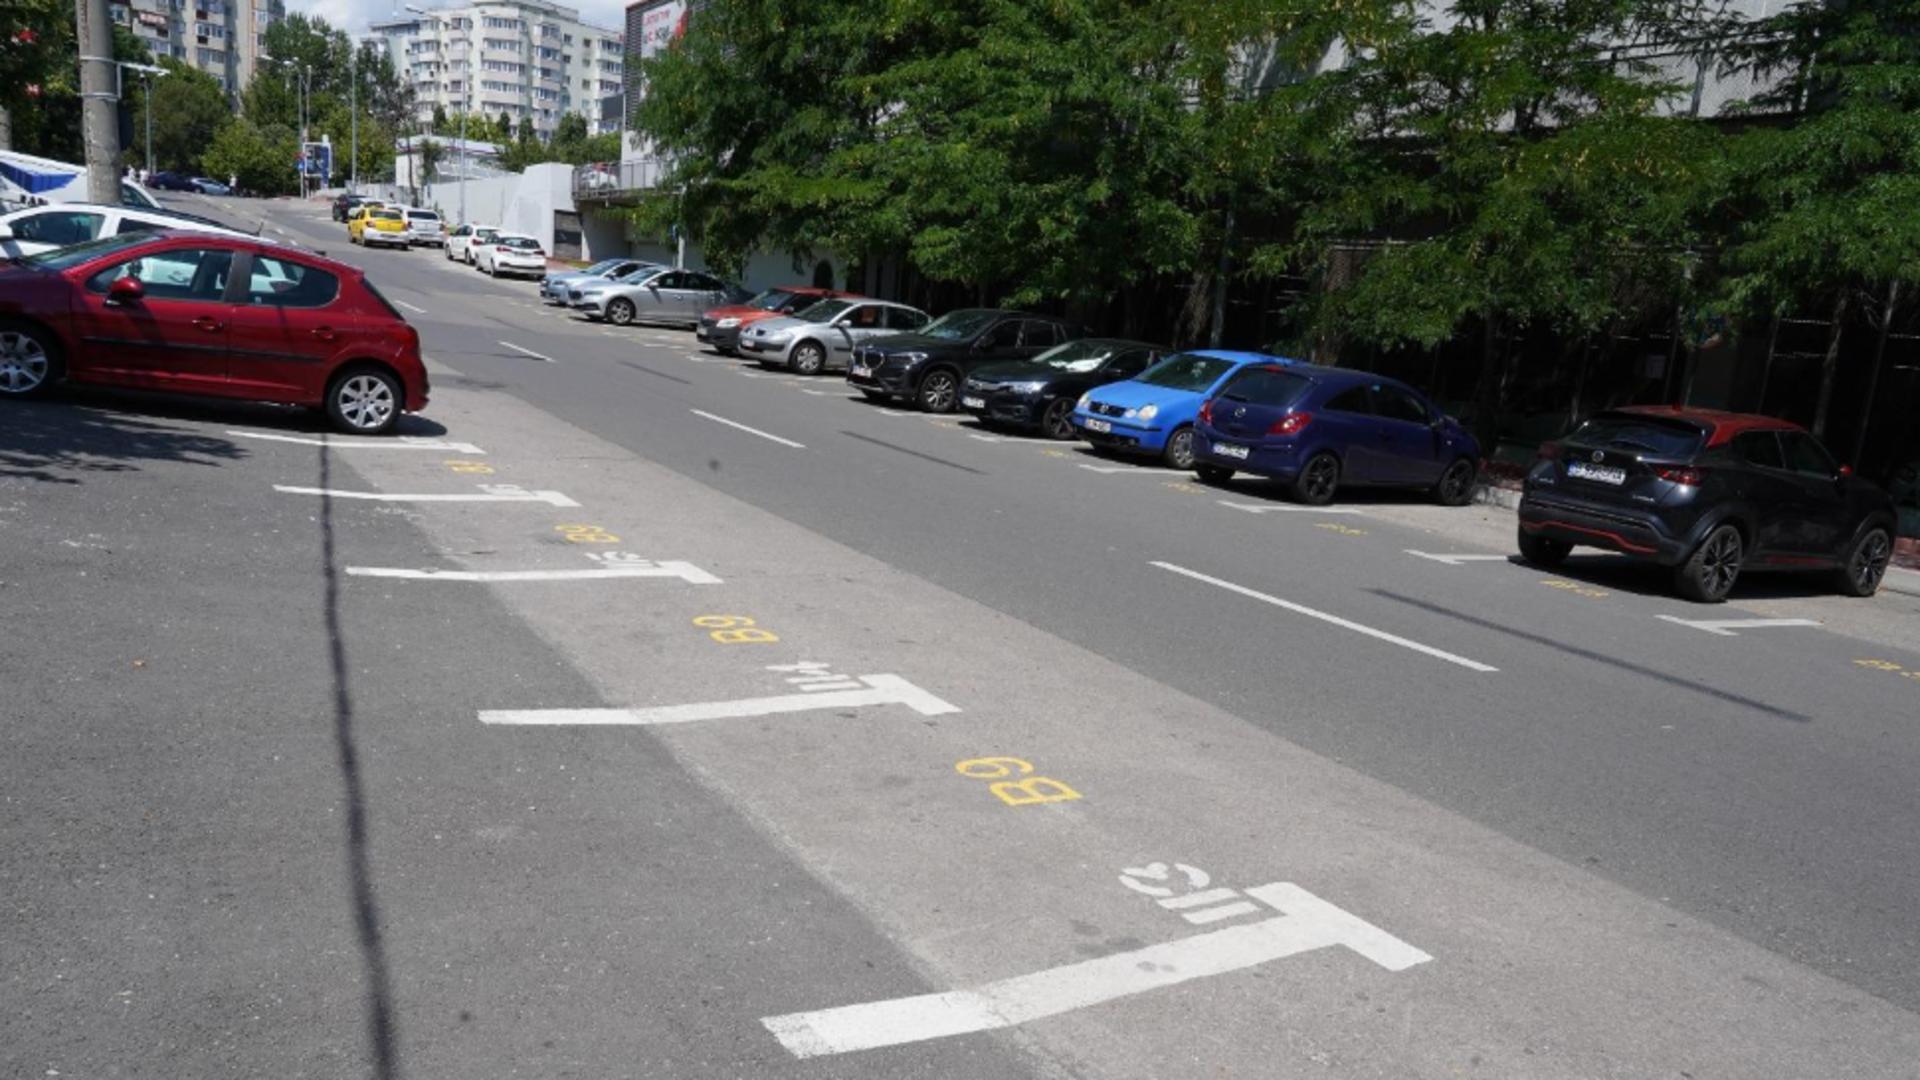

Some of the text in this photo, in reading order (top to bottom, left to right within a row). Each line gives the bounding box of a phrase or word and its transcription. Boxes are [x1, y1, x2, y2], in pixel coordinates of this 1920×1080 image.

[555, 523, 620, 544] B9
[692, 615, 779, 644] B9
[765, 661, 861, 691] 114
[954, 756, 1083, 806] B9
[1118, 863, 1240, 925] 113
